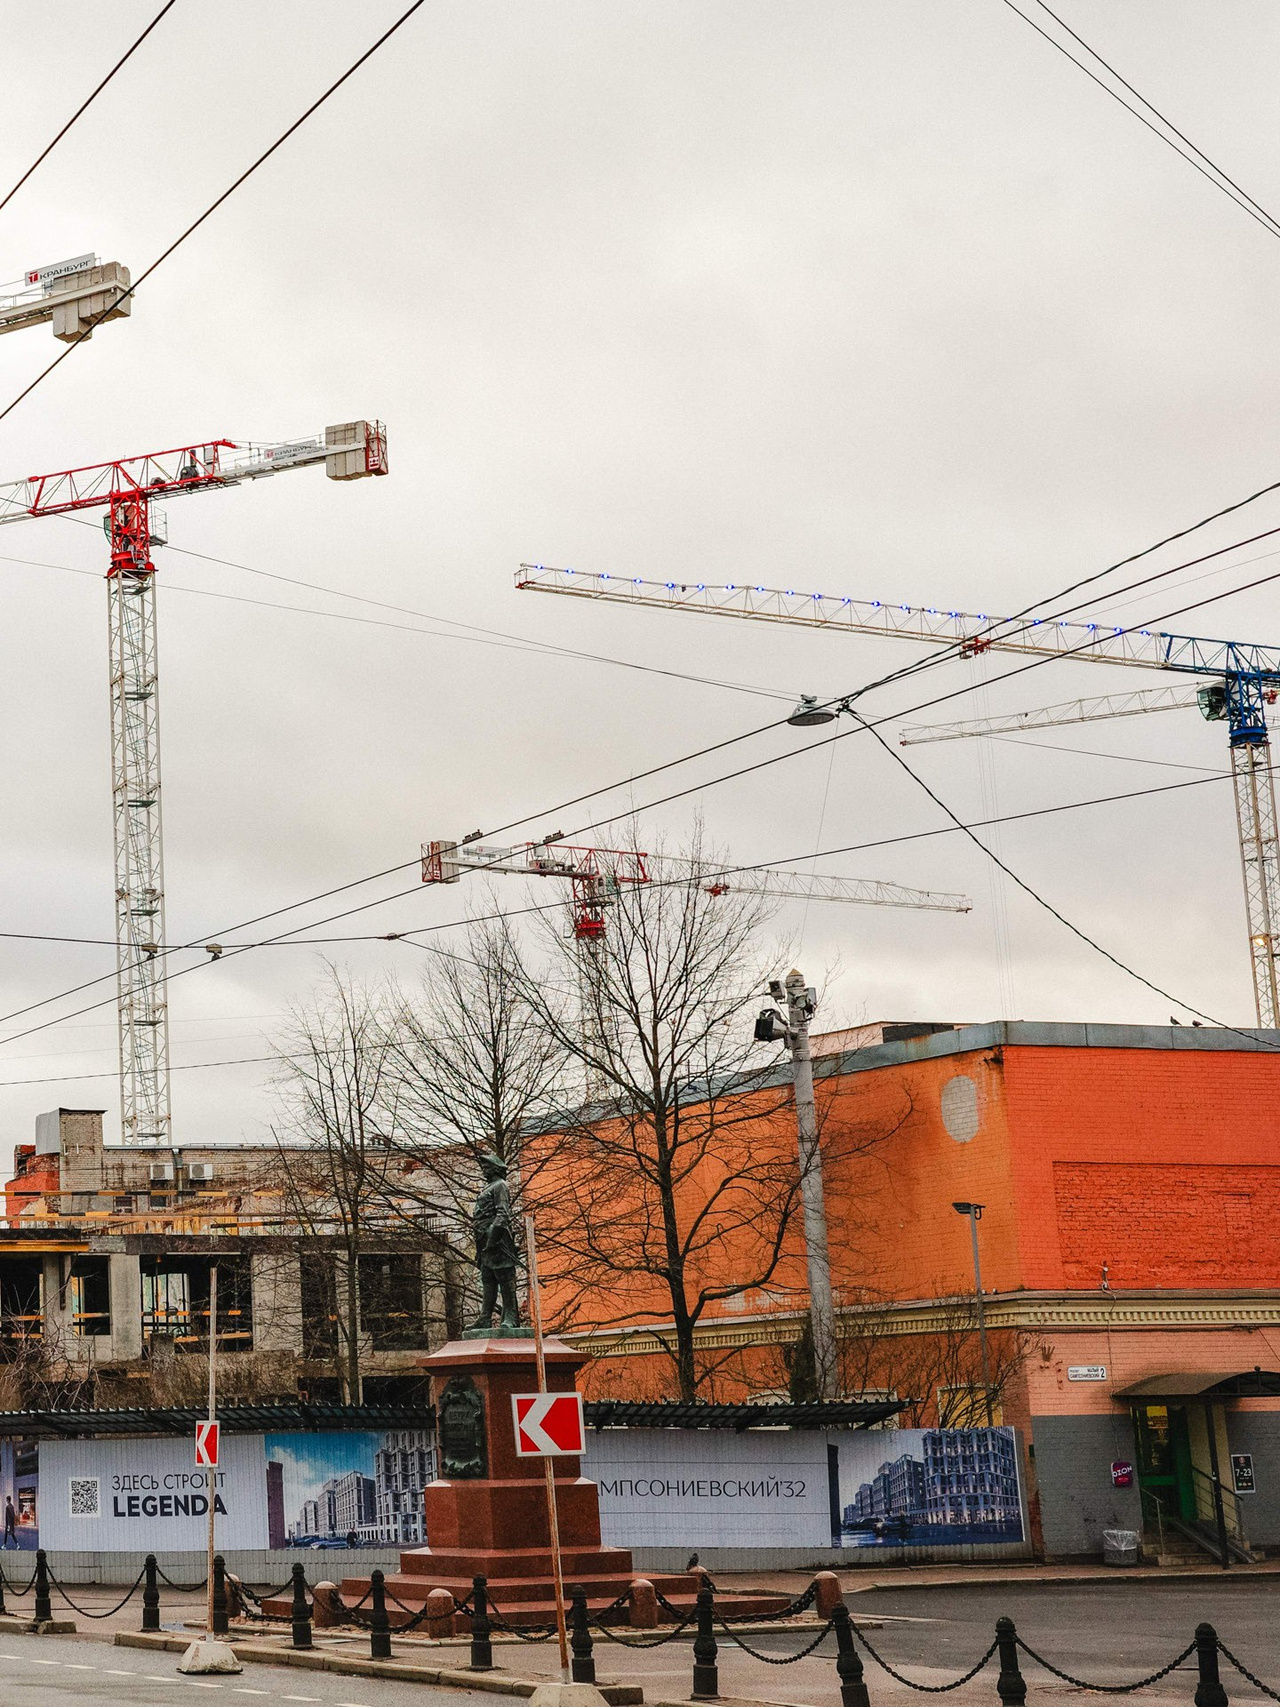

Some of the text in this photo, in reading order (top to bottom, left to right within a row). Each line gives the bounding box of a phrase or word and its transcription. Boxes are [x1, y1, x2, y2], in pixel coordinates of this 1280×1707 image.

[39, 1260, 91, 1280] КРАНБУРГ
[1100, 1368, 1105, 1378] 2
[1111, 1465, 1133, 1478] OZON
[1235, 1468, 1252, 1477] 7-23
[111, 1474, 159, 1493] ЗДЕСЬ
[113, 1493, 228, 1518] LEGENDA
